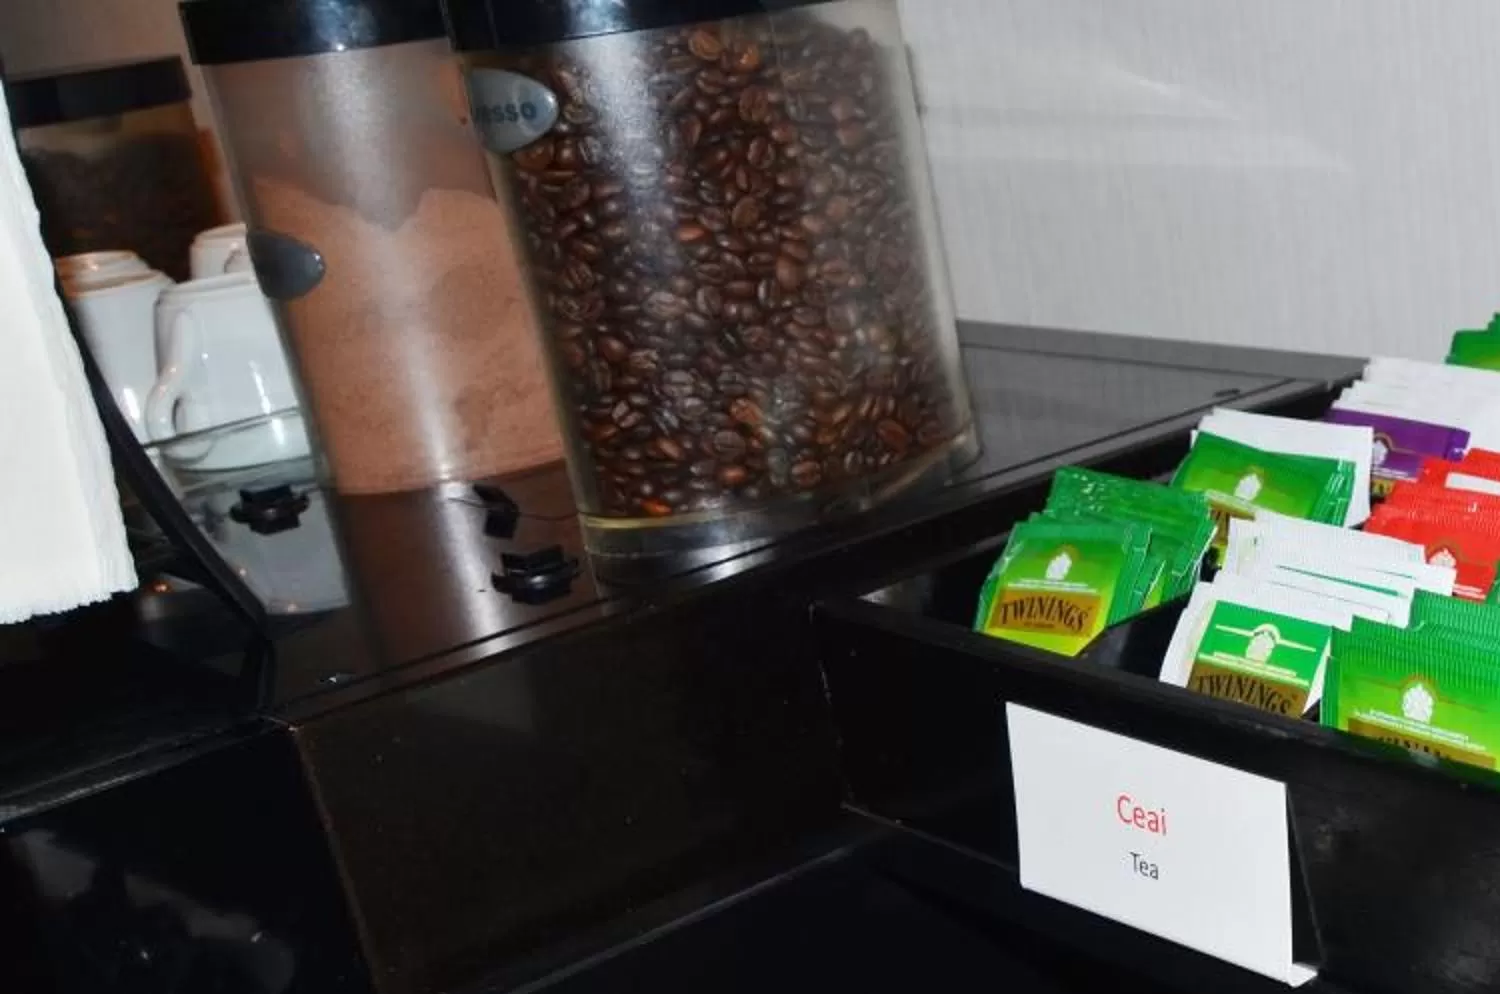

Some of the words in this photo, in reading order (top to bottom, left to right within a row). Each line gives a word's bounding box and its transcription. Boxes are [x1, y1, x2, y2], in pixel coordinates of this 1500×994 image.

[1001, 595, 1092, 633] TWININGS
[1117, 794, 1167, 836] Ceai
[1129, 851, 1159, 881] Tea
